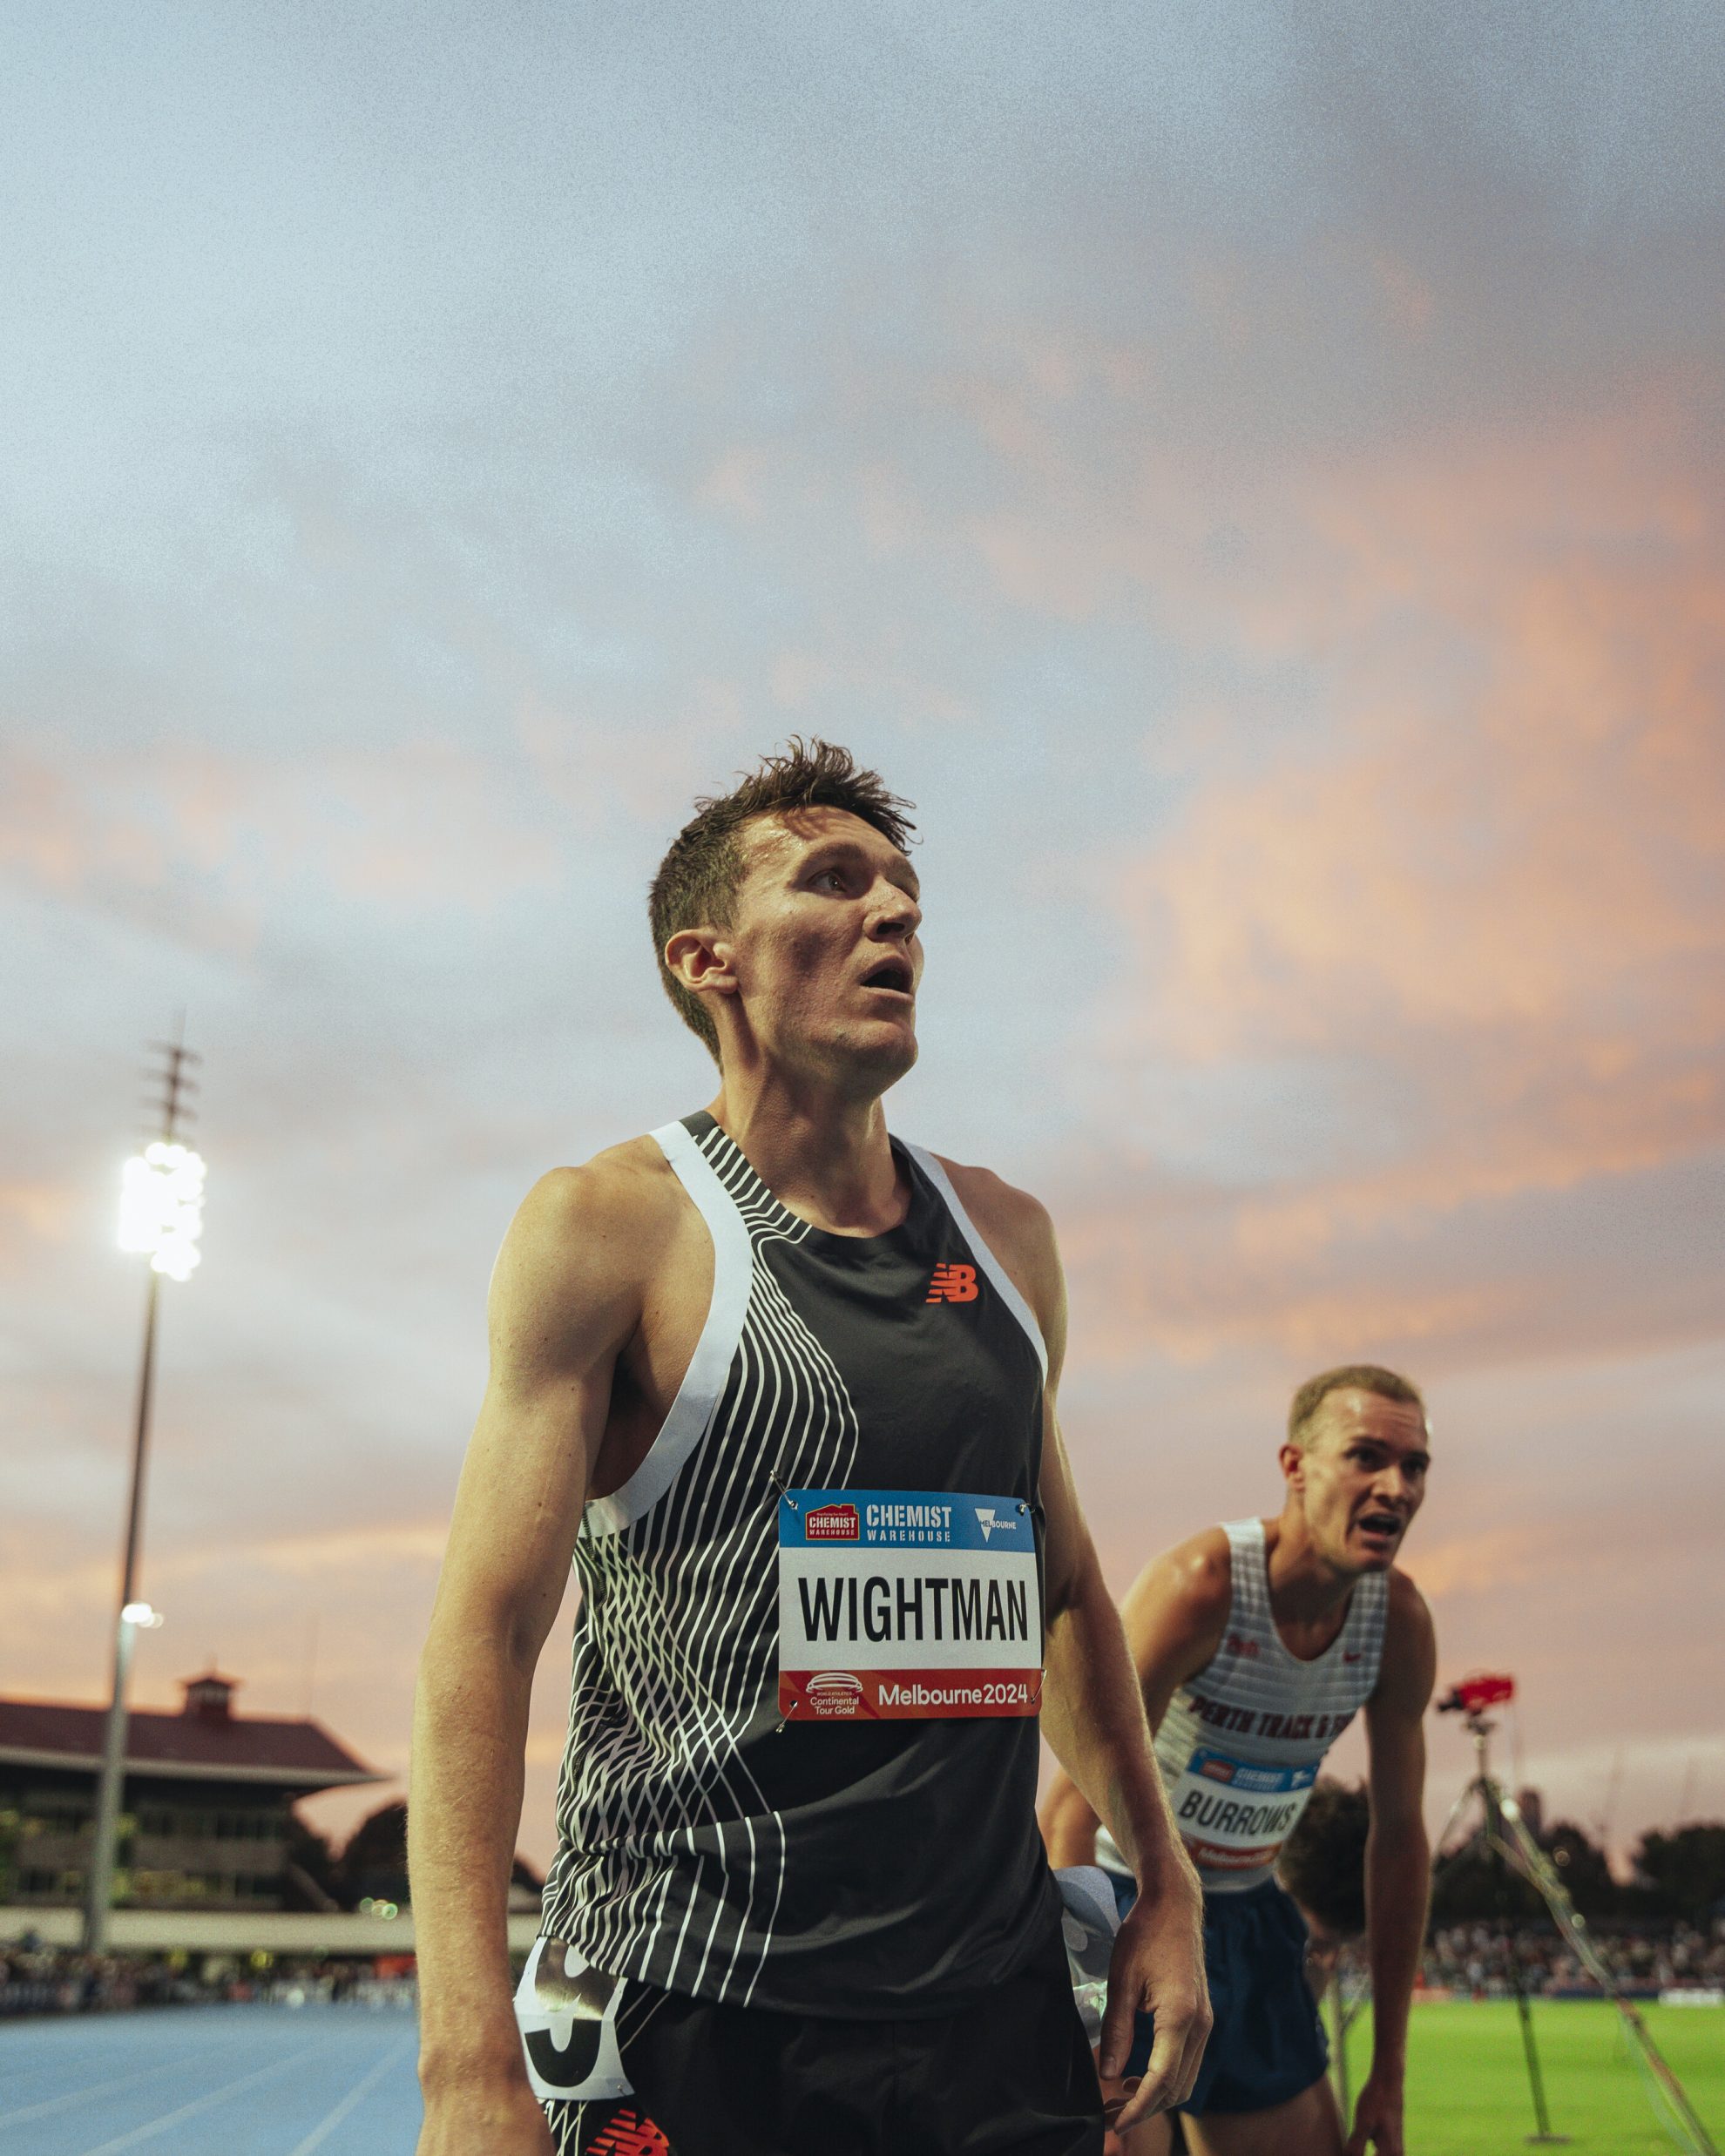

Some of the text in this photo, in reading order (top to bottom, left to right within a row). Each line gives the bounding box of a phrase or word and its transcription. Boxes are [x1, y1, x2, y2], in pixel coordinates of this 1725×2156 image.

[925, 1263, 979, 1303] NB
[809, 1517, 856, 1529] CHEMIST
[866, 1504, 951, 1528] CHEMIST
[867, 1530, 950, 1542] WAREHOUSE
[798, 1576, 1028, 1642] WIGHTMAN
[810, 1696, 859, 1706] Continental
[815, 1706, 855, 1714] Tour Gold
[1187, 1694, 1256, 1734] PERTH
[1257, 1713, 1313, 1739] TRACK
[1179, 1789, 1295, 1835] BURROWS
